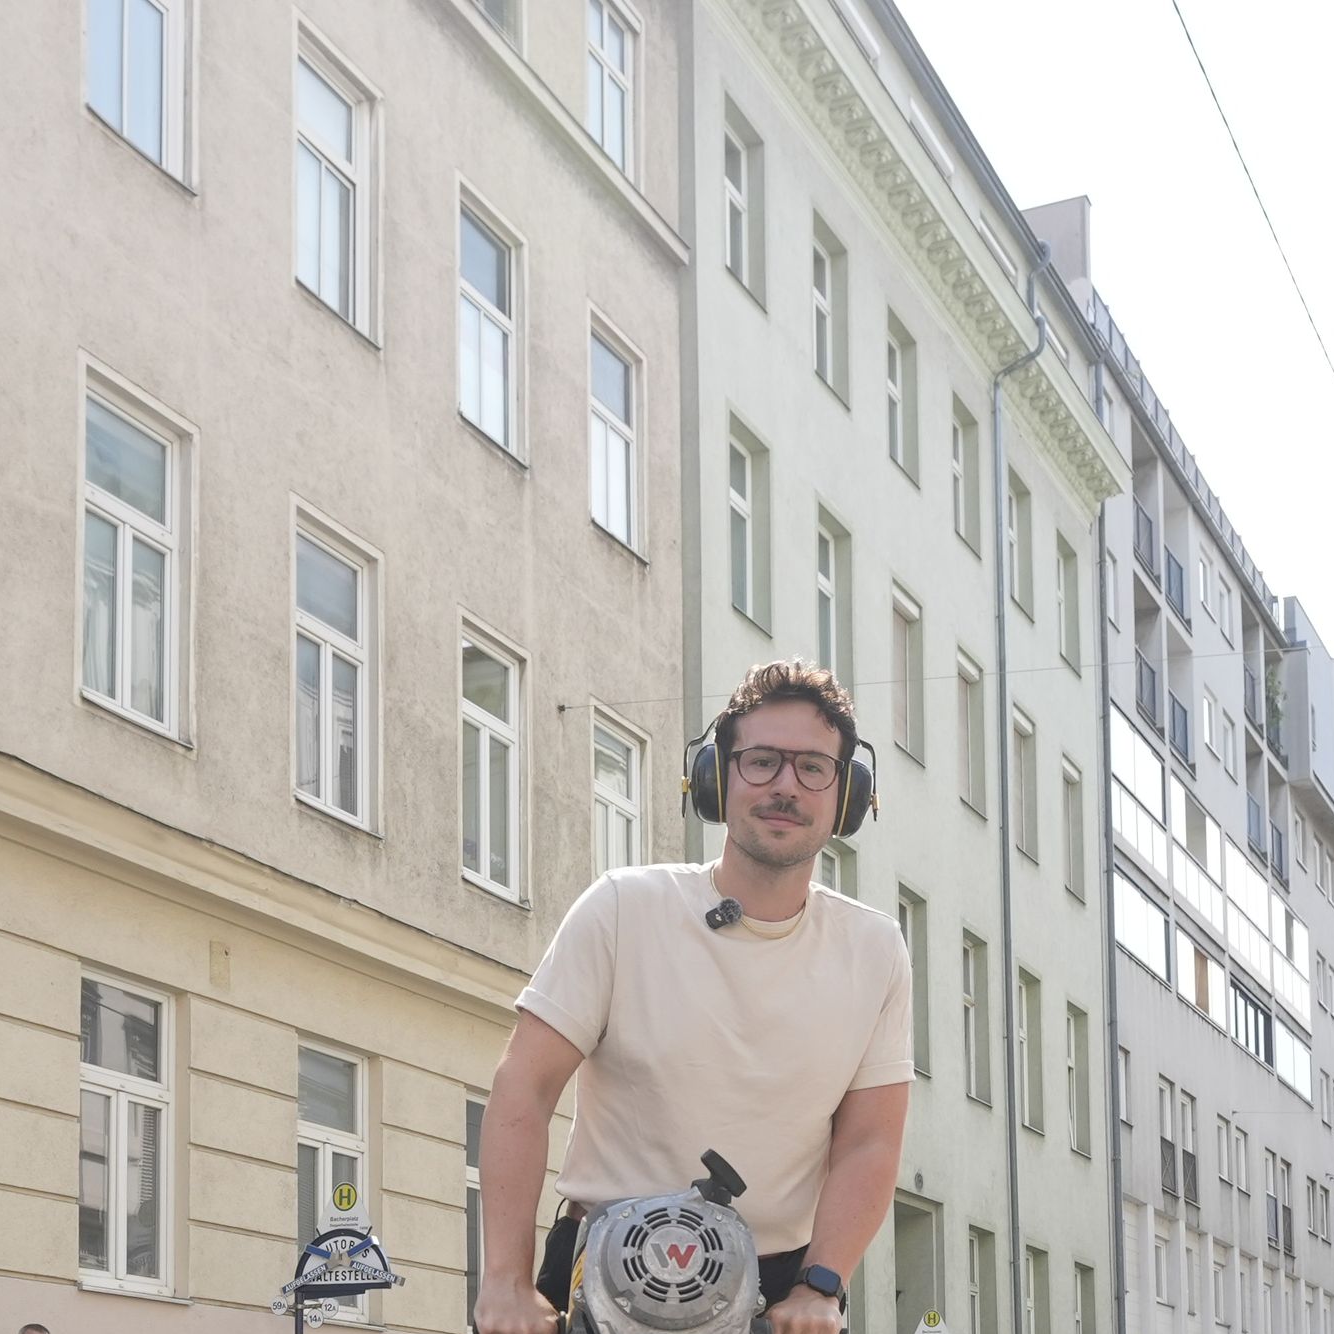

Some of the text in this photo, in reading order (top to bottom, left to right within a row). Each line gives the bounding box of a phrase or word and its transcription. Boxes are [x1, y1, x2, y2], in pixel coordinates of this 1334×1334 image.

[339, 1188, 351, 1206] H
[285, 1264, 327, 1292] AUFGELASSEN
[351, 1261, 396, 1282] AUFGELASSEN
[272, 1302, 286, 1310] 59A
[324, 1304, 336, 1312] 12A
[309, 1315, 321, 1323] 14A
